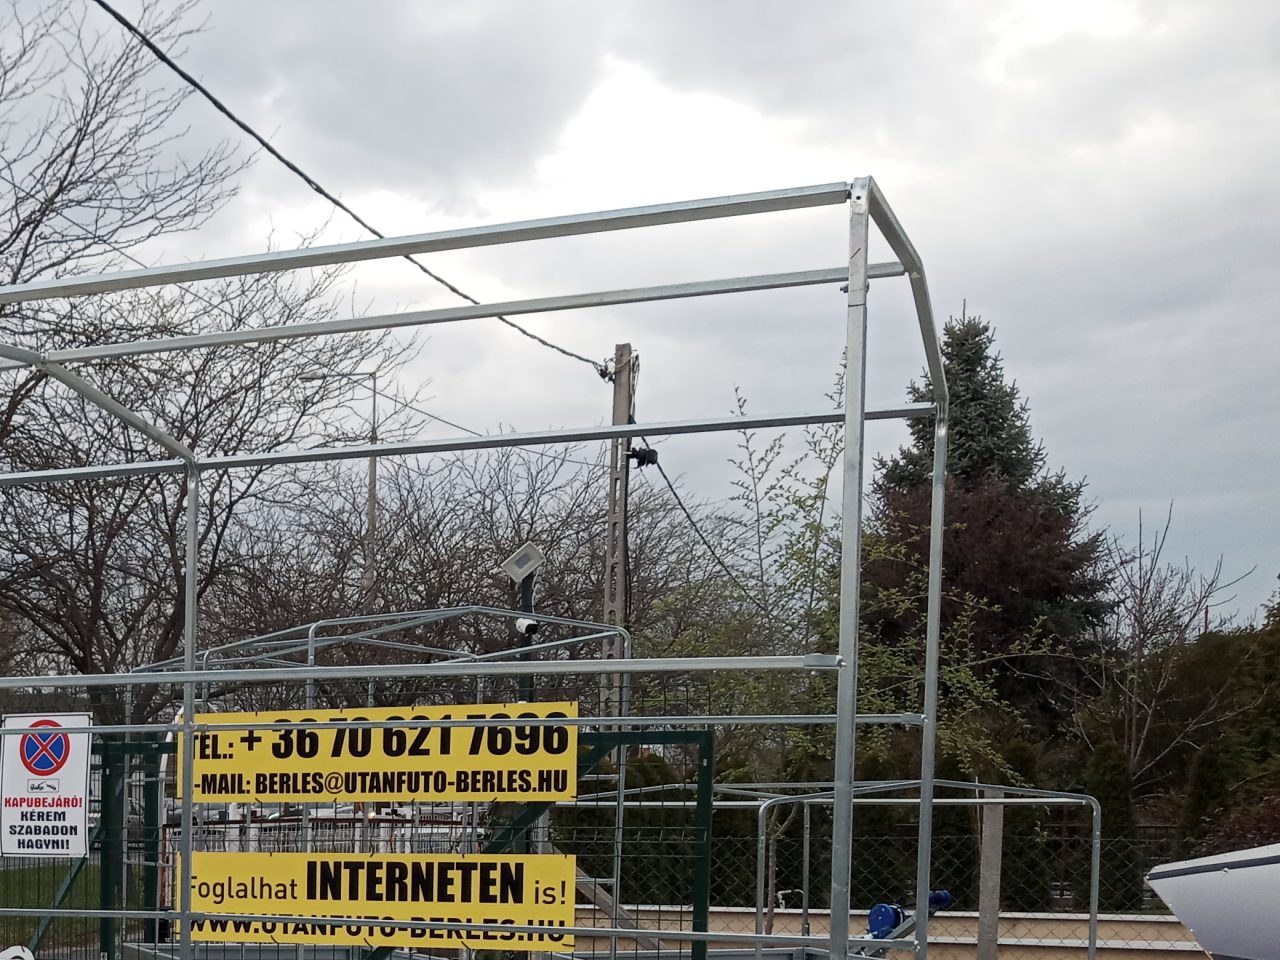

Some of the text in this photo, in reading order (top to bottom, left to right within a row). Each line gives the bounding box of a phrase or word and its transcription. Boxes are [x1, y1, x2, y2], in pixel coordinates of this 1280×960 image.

[271, 718, 320, 759] 36
[329, 716, 372, 758] 70
[382, 714, 452, 757] 621
[466, 711, 569, 756] 7696
[194, 769, 569, 795] -MAIL: BERLES@UTANFUTO-BERLES.HU
[4, 795, 83, 808] KAPUBEJÁRÓ!
[20, 809, 66, 822] KÉREM
[9, 825, 78, 836] SZABADON
[17, 839, 70, 850] HAGYNI!
[306, 860, 525, 904] INTERNETEN
[534, 880, 567, 905] is!
